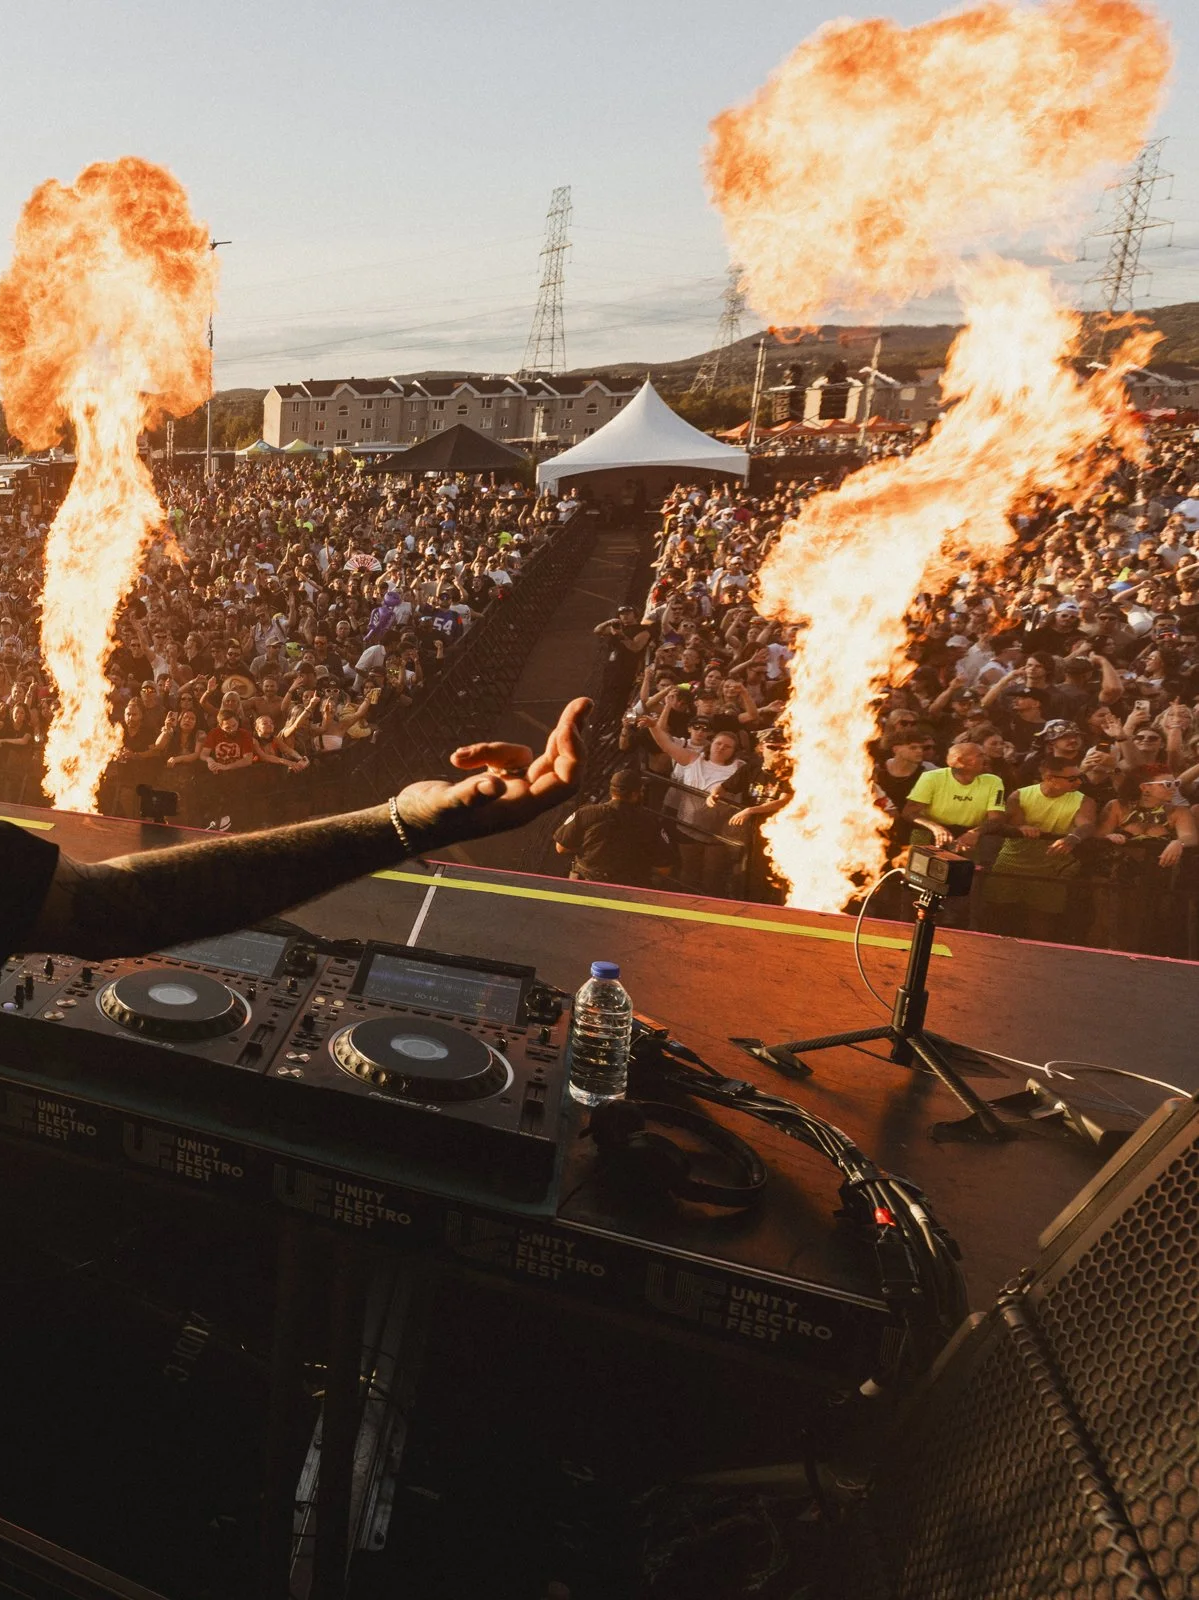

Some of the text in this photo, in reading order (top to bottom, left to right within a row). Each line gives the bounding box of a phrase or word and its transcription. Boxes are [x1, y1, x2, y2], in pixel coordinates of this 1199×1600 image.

[433, 616, 453, 631] 54
[38, 1100, 76, 1118] UNITY
[38, 1112, 97, 1136] ELECTRO
[38, 1124, 68, 1140] FEST
[177, 1137, 220, 1158] UNITY
[176, 1150, 244, 1178] ELECTRO
[176, 1163, 210, 1182] FEST
[336, 1181, 384, 1204] UNITY
[334, 1209, 374, 1229] FEST
[335, 1195, 412, 1224] ELECTRO
[519, 1230, 576, 1254] UNITY
[516, 1259, 561, 1281] FEST
[517, 1244, 605, 1278] ELECTRO
[731, 1286, 799, 1314] UNITY
[726, 1317, 780, 1342] FEST
[729, 1302, 833, 1340] ELECTRO
